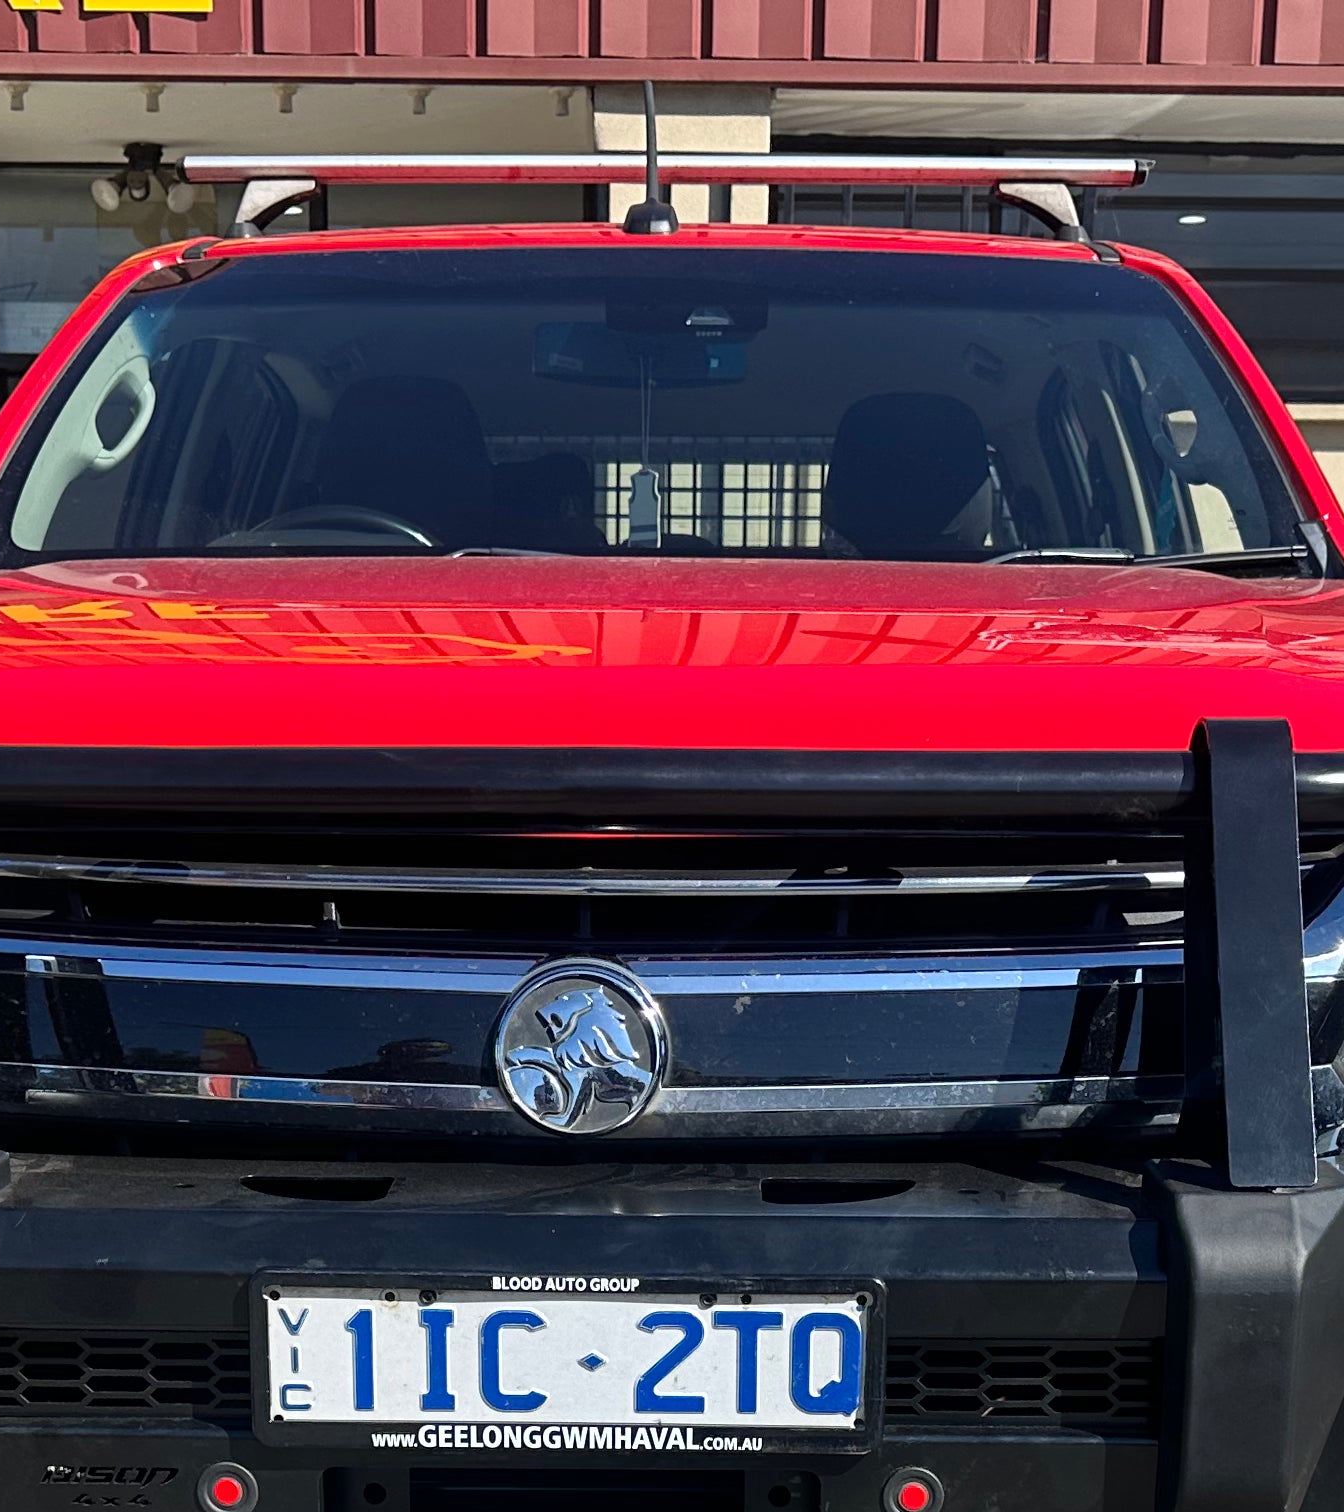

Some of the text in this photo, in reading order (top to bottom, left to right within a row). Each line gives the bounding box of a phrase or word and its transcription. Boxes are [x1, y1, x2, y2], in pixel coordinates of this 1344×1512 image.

[492, 1276, 640, 1292] BLOOD AUTO GROUP
[371, 1424, 763, 1452] www.GEELONGGWMHAVAL.COM.AU
